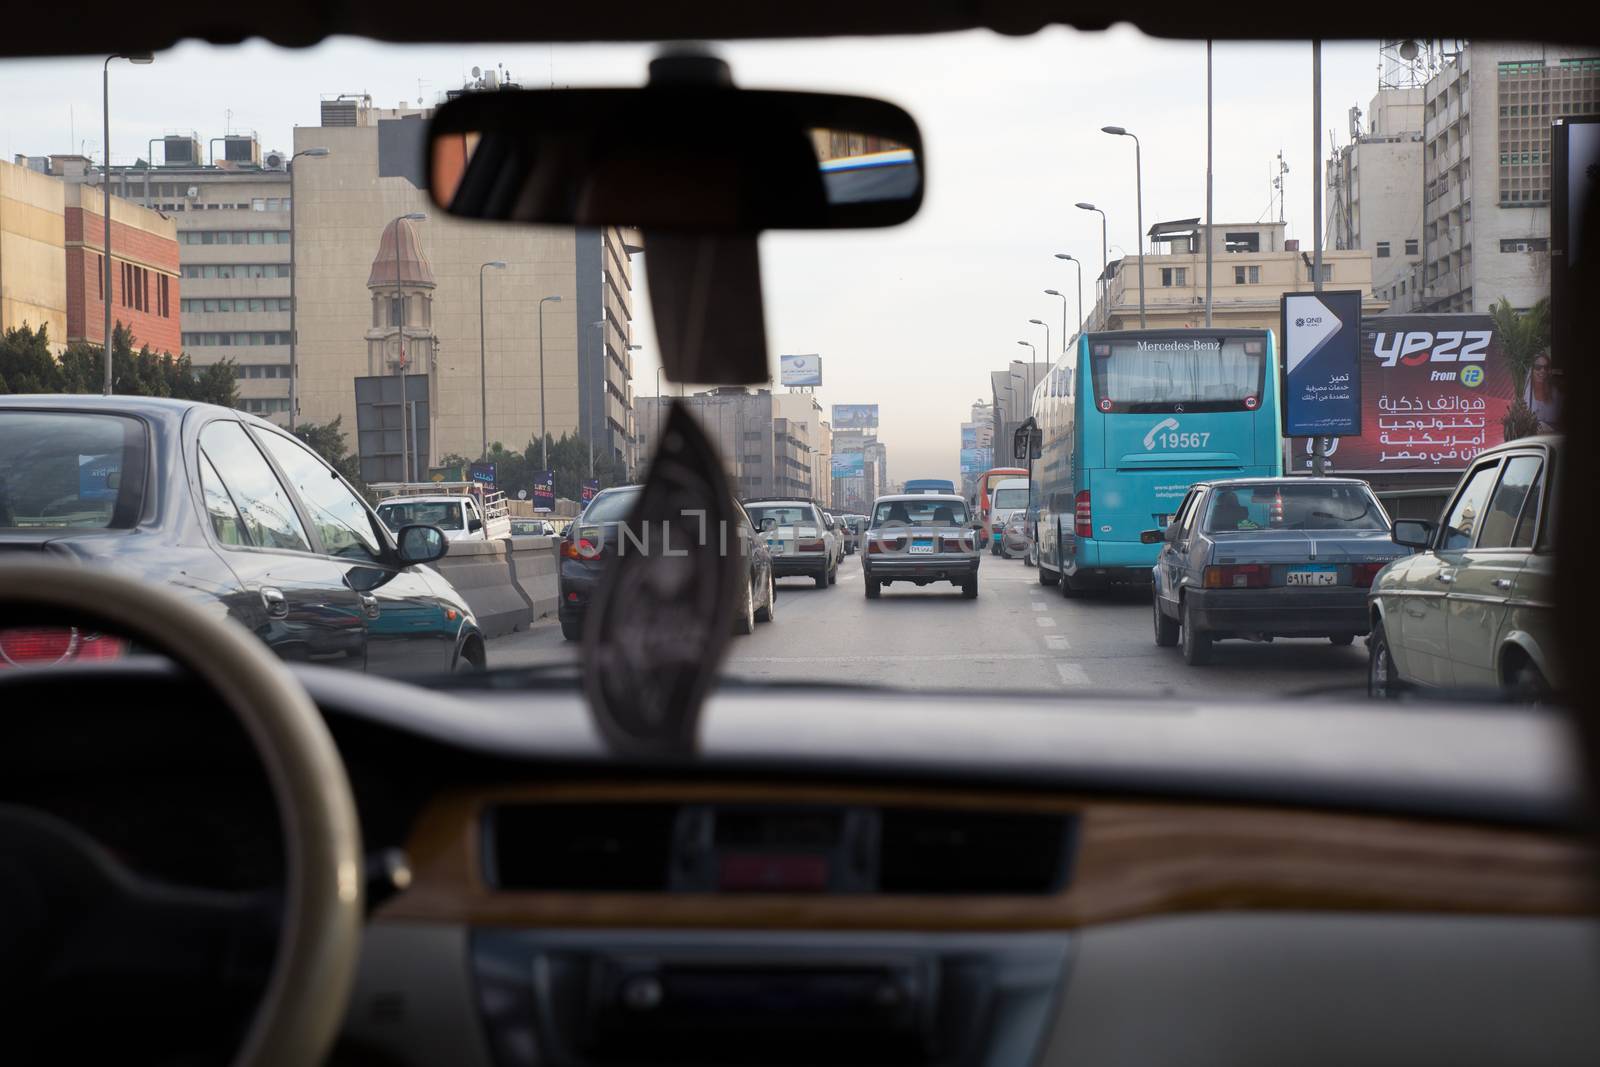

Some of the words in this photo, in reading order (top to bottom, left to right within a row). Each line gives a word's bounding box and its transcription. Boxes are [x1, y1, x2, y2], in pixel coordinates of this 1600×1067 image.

[1137, 340, 1220, 352] Mercedes-Benz
[1329, 373, 1350, 384] تميز
[1430, 370, 1457, 382] From
[1318, 394, 1328, 402] من
[1378, 395, 1424, 414] ذكية
[1427, 395, 1486, 413] هواتف
[1379, 417, 1486, 431] تكنولوجيا
[1159, 432, 1210, 449] 19567
[1379, 429, 1486, 447] أمريكية
[1379, 450, 1427, 463] مصر
[1430, 447, 1458, 465] في
